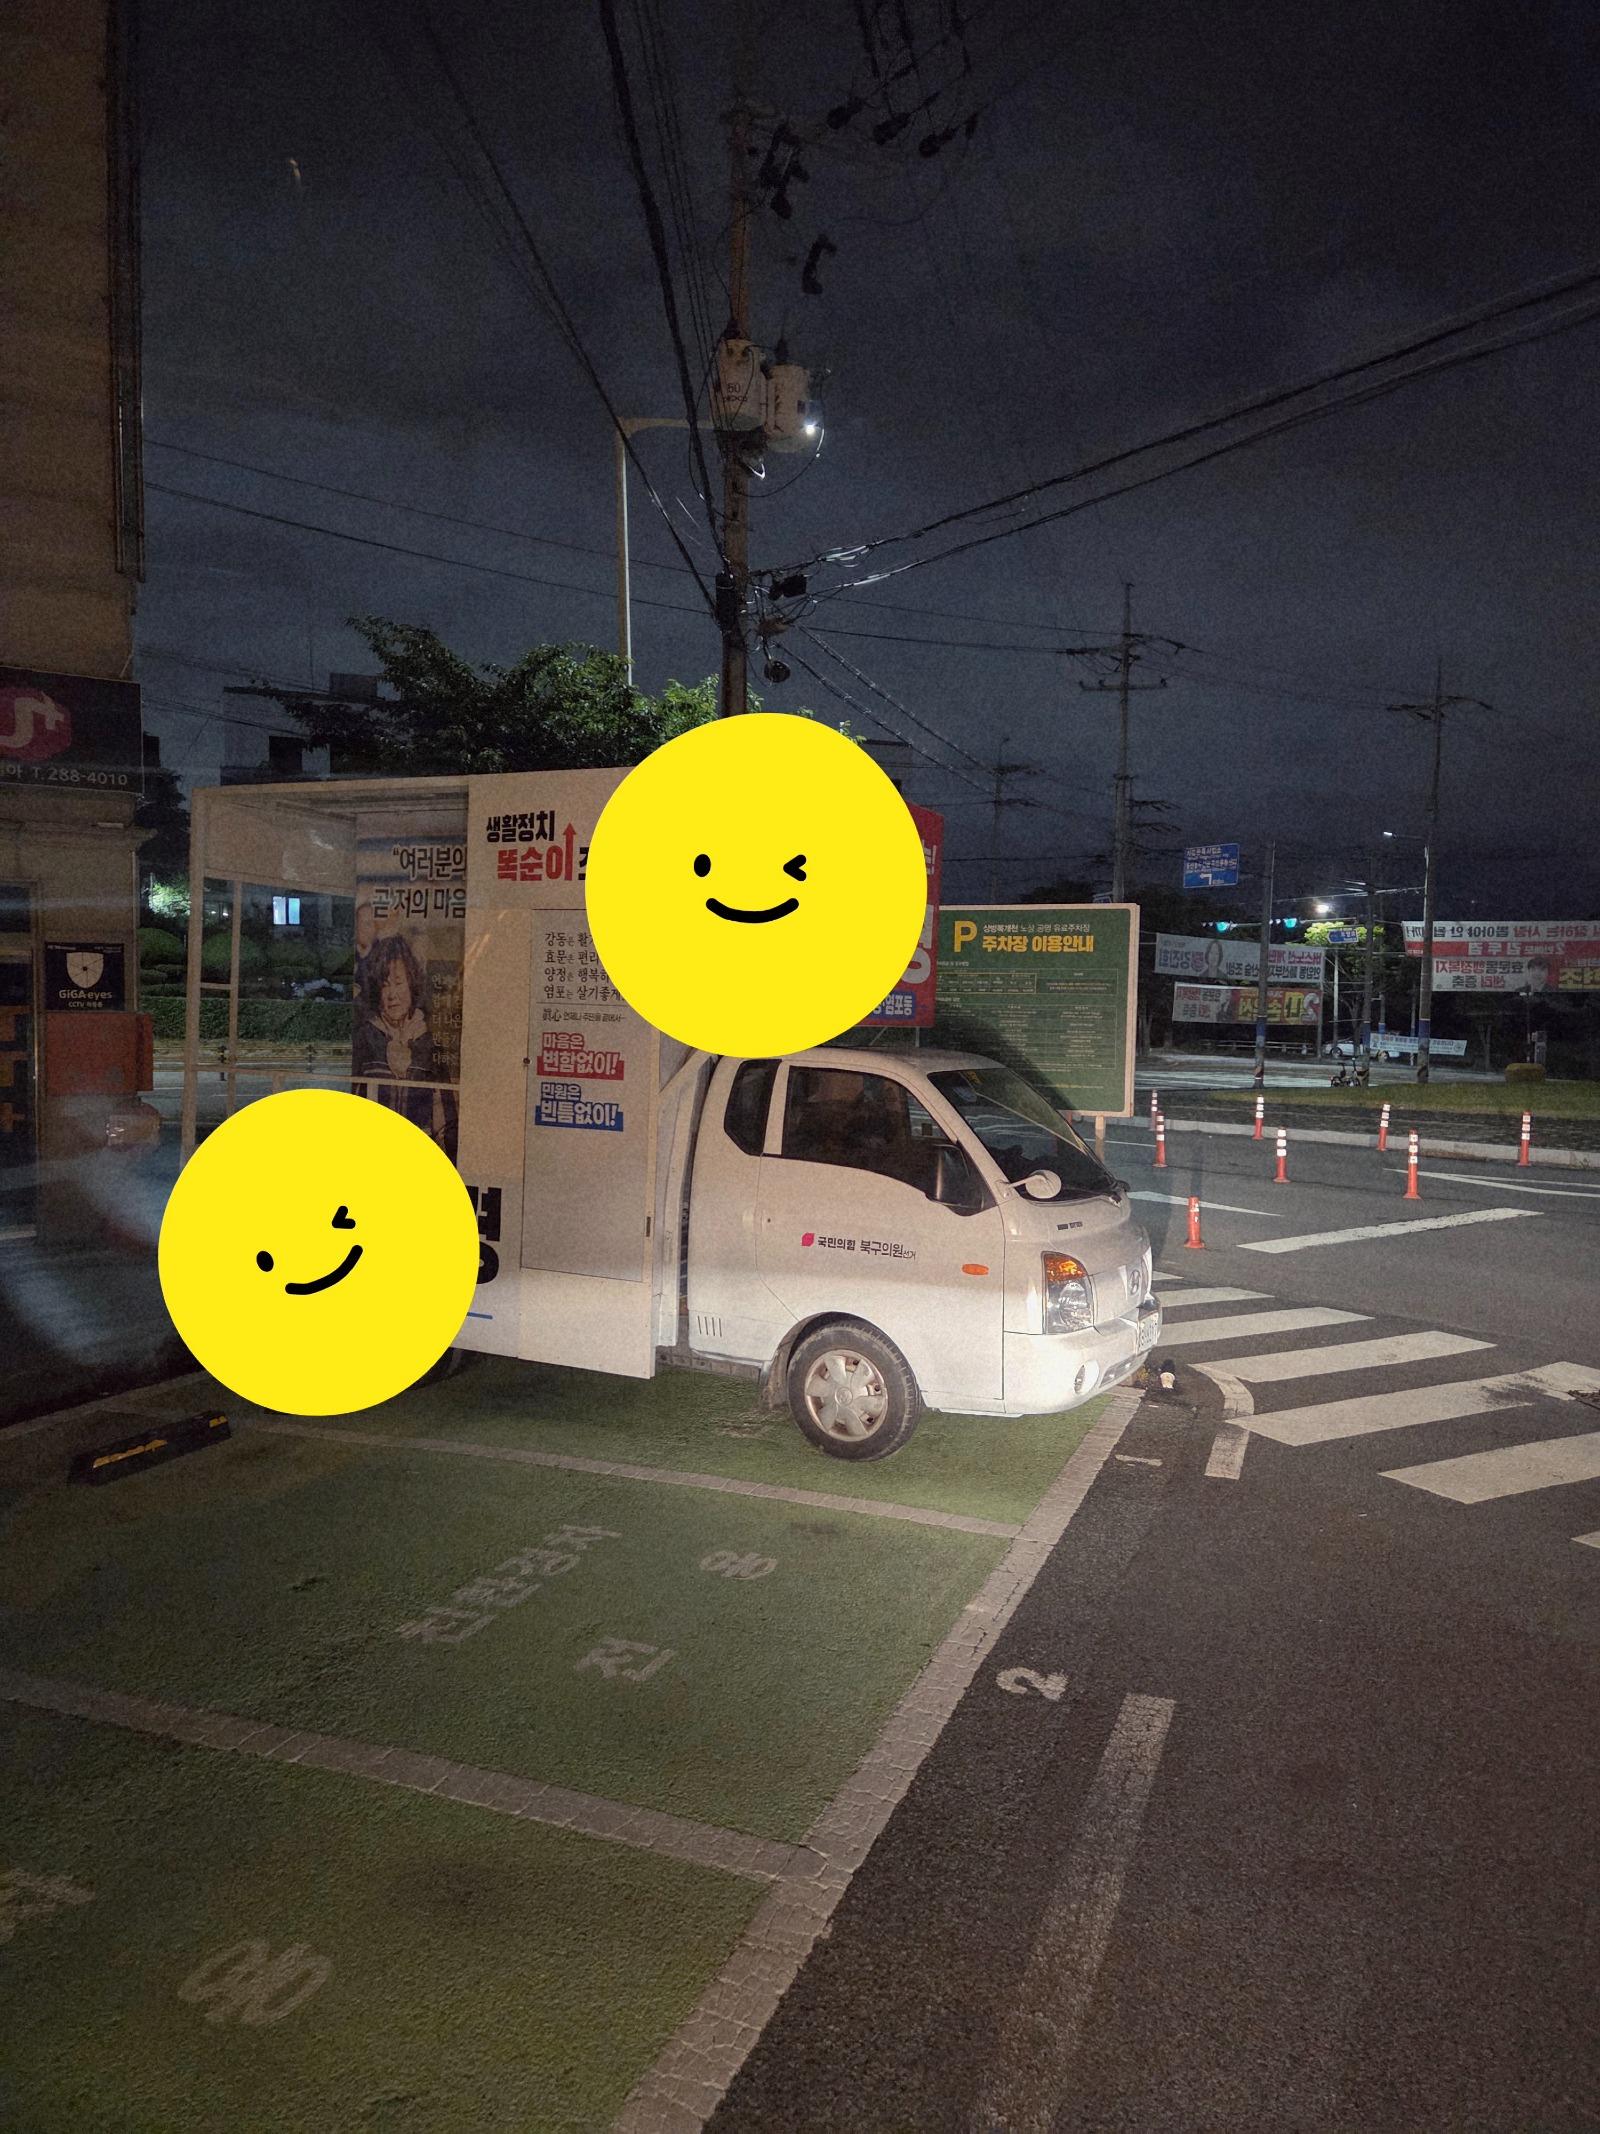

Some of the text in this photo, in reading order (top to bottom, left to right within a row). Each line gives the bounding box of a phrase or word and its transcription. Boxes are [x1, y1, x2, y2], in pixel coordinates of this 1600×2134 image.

[486, 810, 555, 842] 생활정치
[393, 888, 428, 918] 저의
[433, 888, 466, 919] 마음
[544, 932, 575, 947] 강동은
[954, 920, 977, 953] P
[982, 935, 1094, 953] 주차장 이용안내
[544, 950, 575, 965] 효문은
[544, 967, 575, 982] 양정은
[543, 985, 574, 1000] 염포는
[543, 1033, 584, 1049] 마음은
[543, 1050, 620, 1075] 변함없이!
[541, 1084, 581, 1100] 민원은
[541, 1100, 618, 1127] 빈틈없이!
[818, 1236, 856, 1251] 국민의힘
[996, 1667, 1070, 1701] 2
